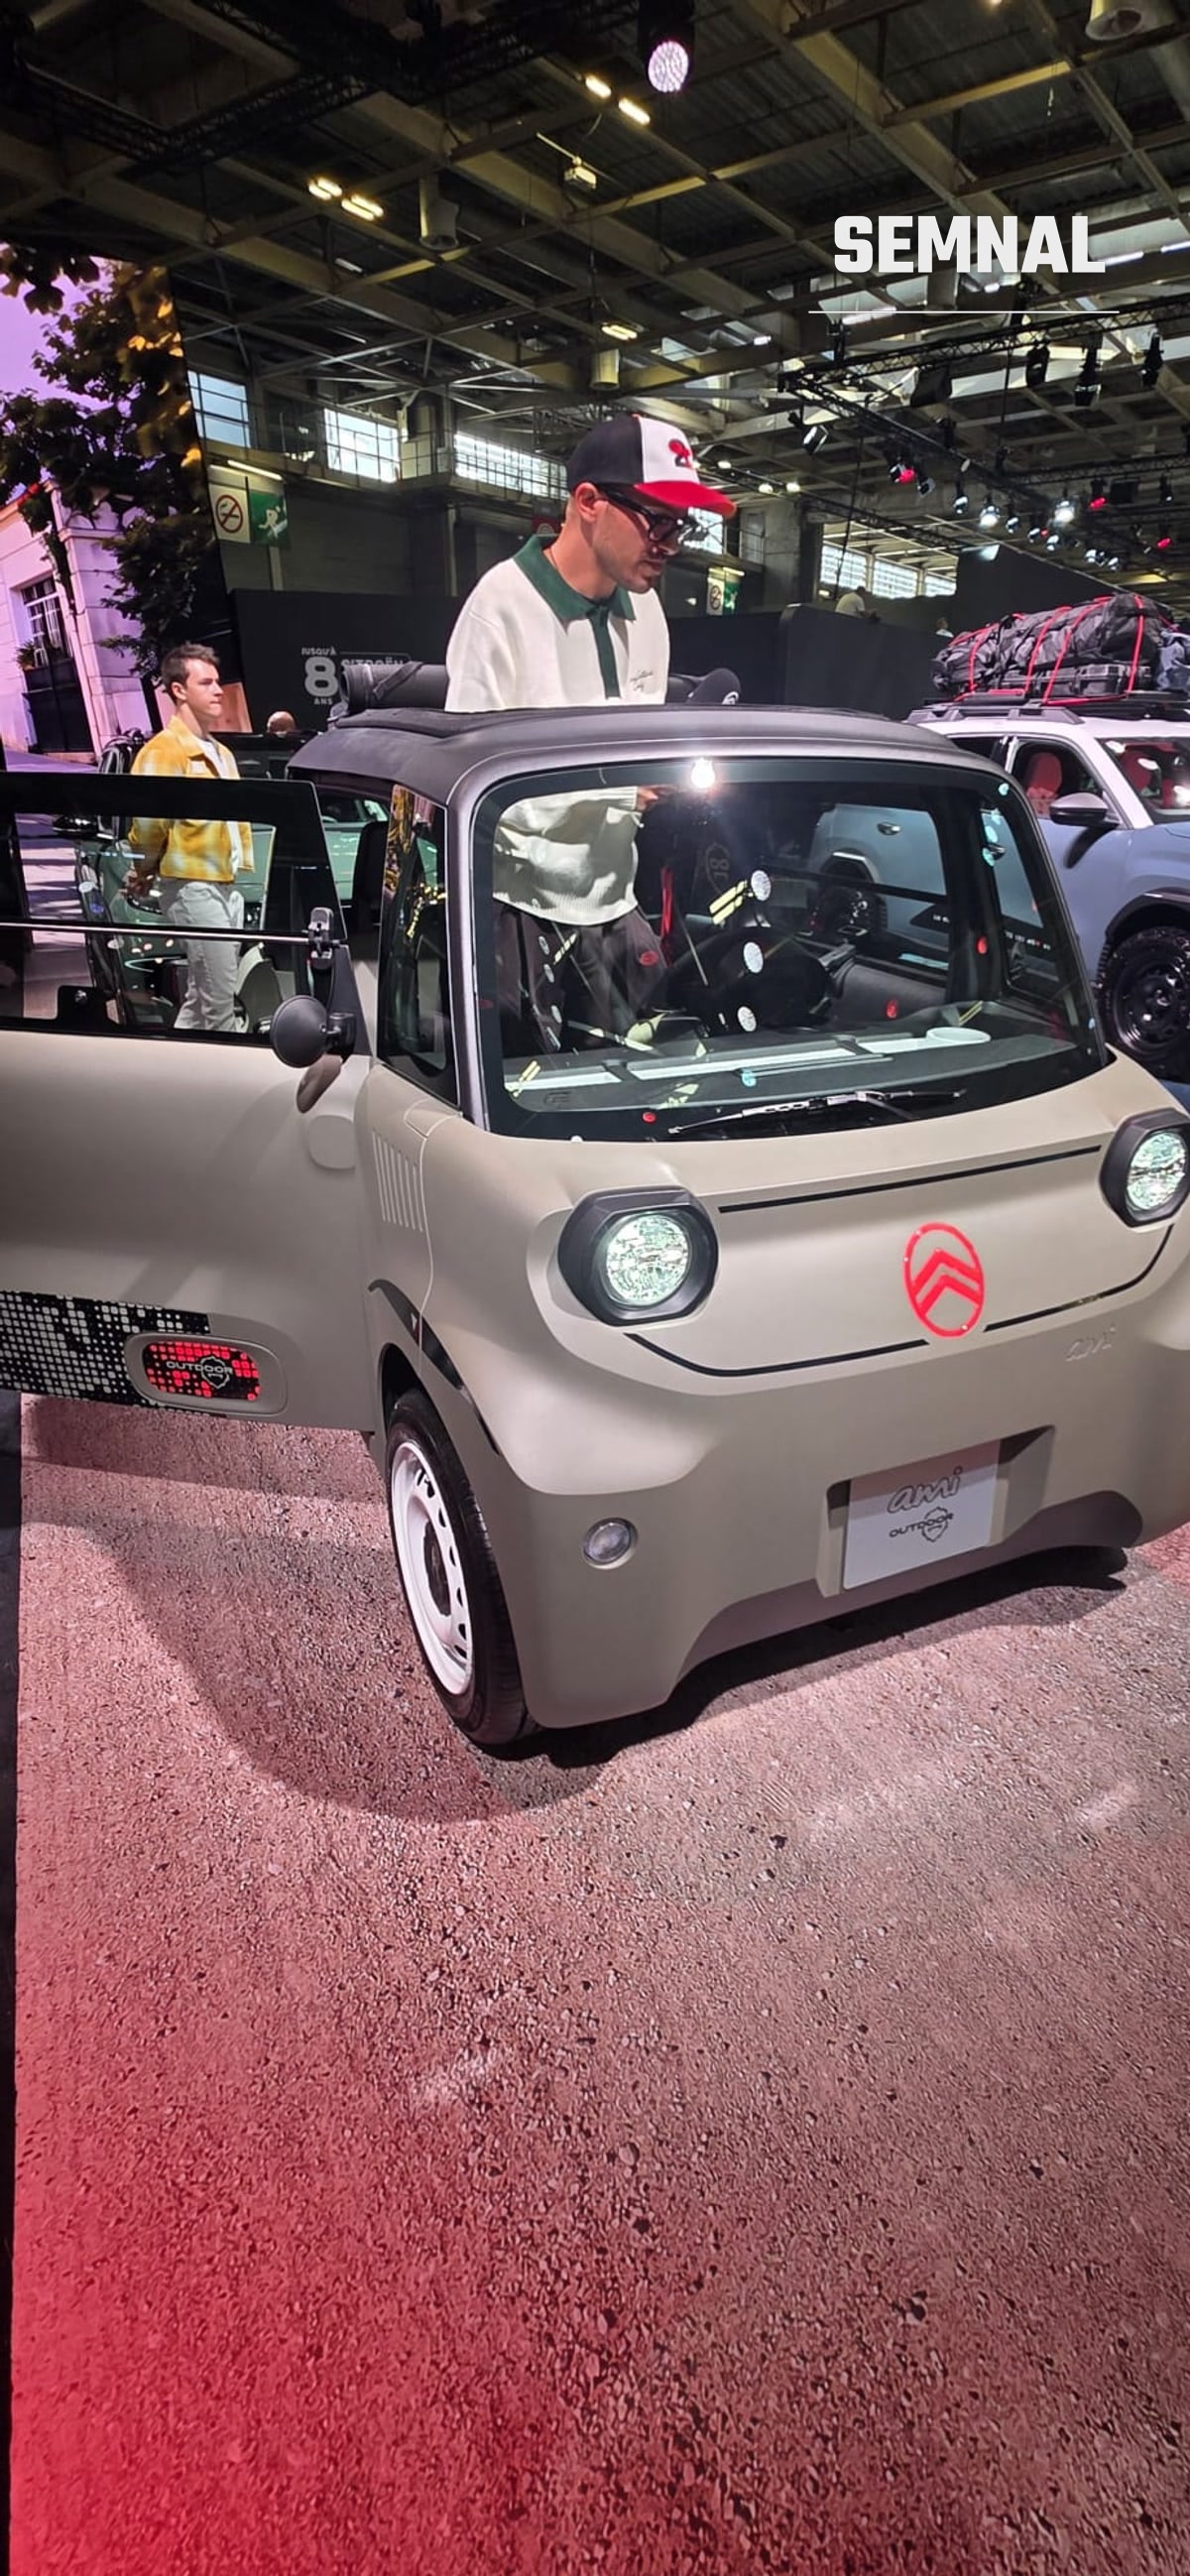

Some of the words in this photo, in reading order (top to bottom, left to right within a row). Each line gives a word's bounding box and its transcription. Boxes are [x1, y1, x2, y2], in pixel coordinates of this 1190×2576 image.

[304, 655, 339, 697] 8
[166, 1361, 233, 1374] OUTDOOR
[887, 1465, 964, 1515] ami
[889, 1513, 954, 1537] OUTDOOR
